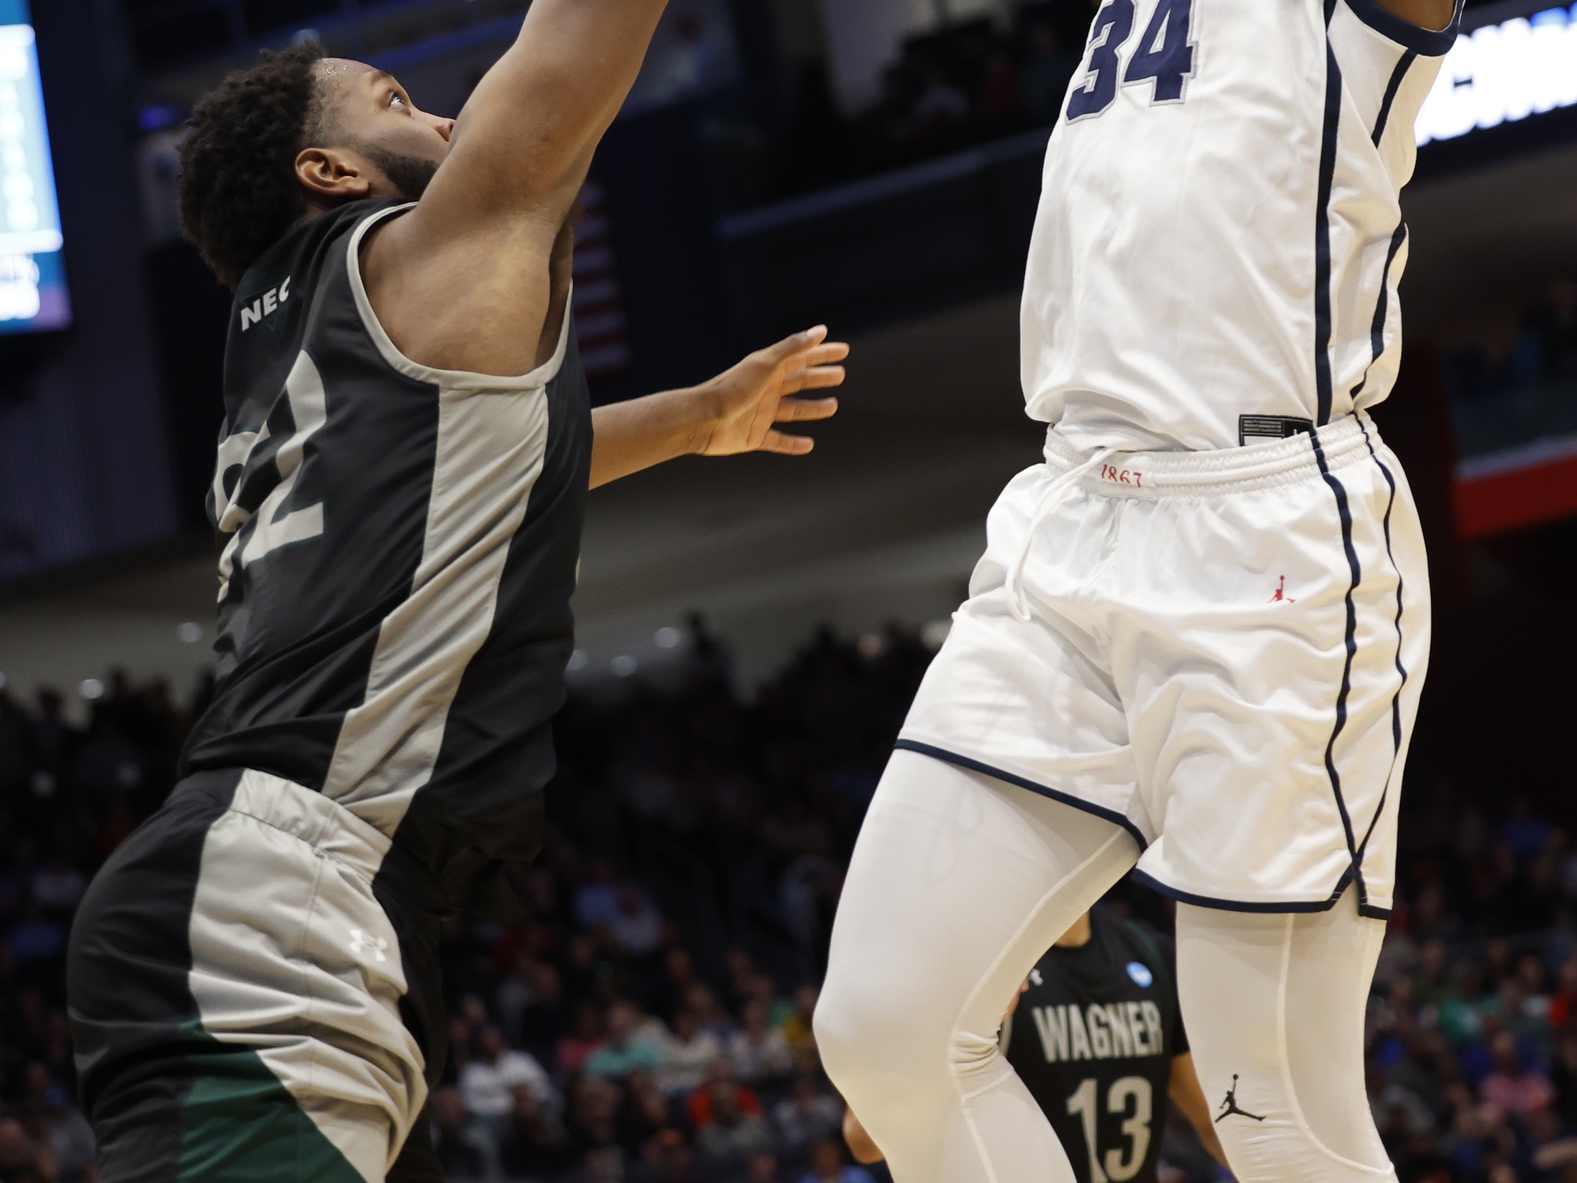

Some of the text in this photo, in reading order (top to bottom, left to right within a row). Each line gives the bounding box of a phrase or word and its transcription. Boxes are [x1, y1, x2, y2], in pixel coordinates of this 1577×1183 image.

[241, 275, 291, 332] NEC
[1032, 1000, 1163, 1063] WAGNER
[1065, 1075, 1153, 1183] 13
